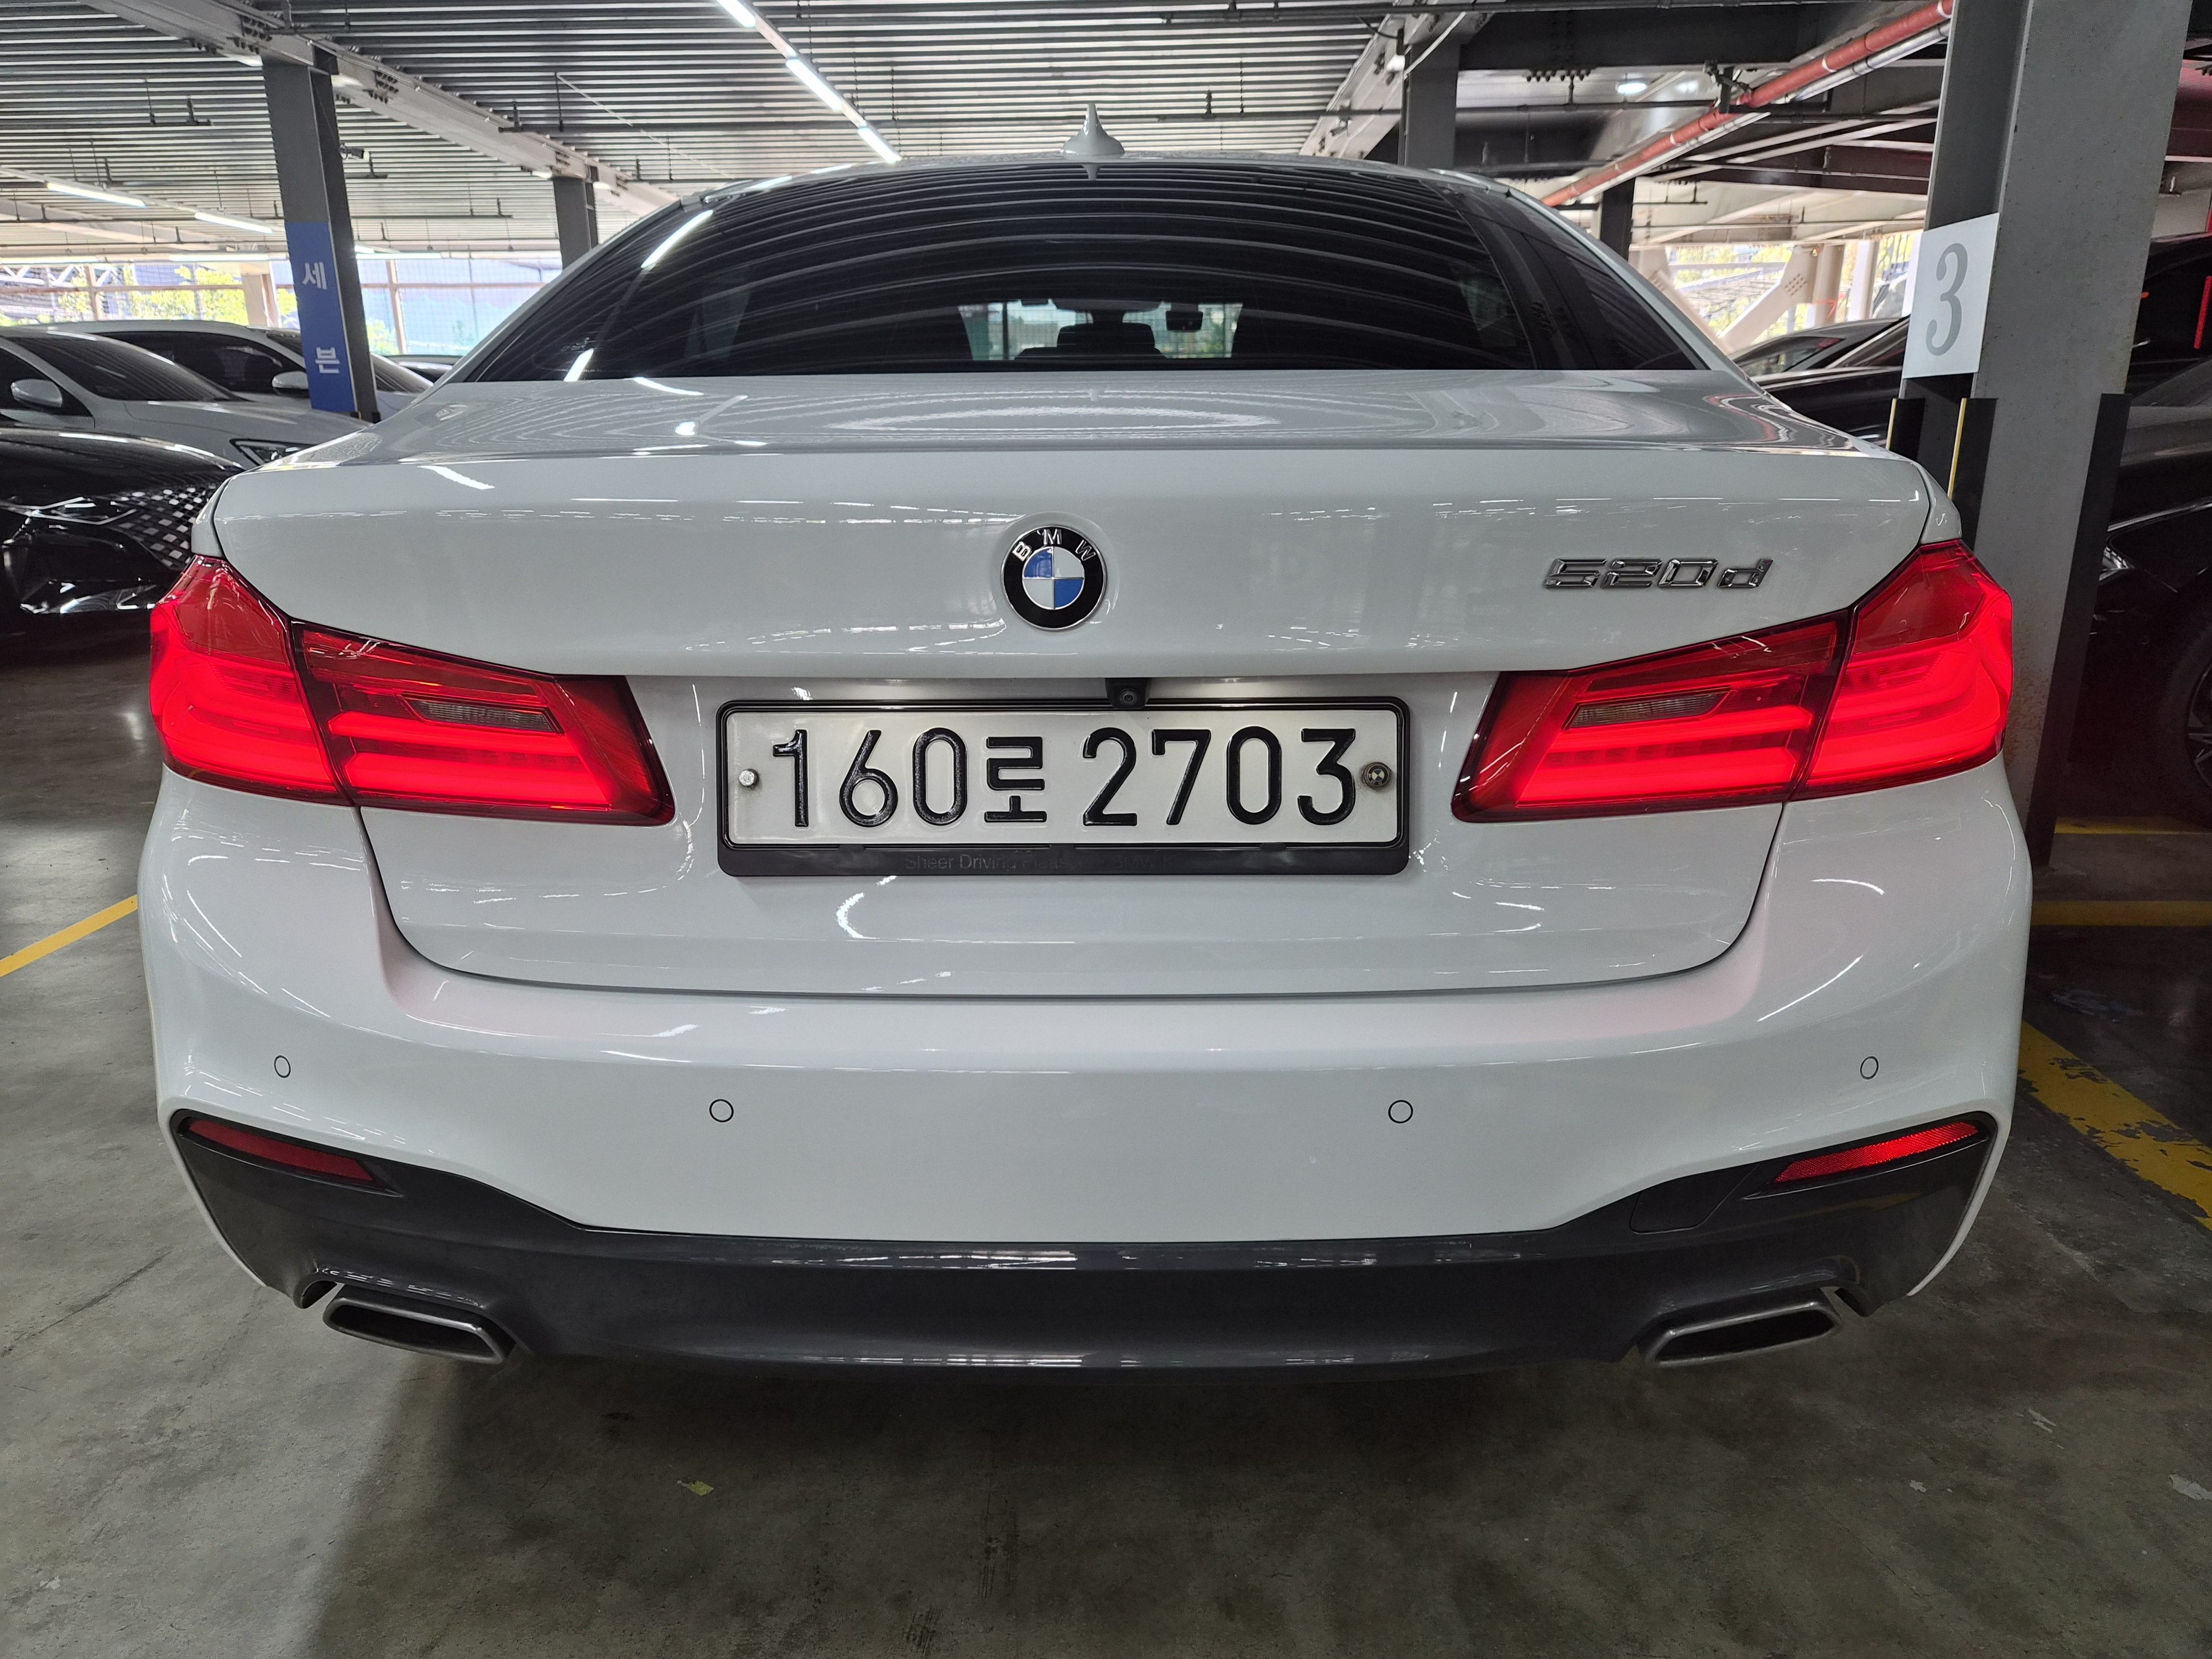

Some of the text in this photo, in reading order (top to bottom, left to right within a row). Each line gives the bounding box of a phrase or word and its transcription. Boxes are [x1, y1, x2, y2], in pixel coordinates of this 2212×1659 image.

[302, 261, 341, 374] 세븐
[1926, 243, 1968, 356] 3
[1012, 529, 1096, 562] BMW
[1543, 558, 1773, 589] 520d
[773, 726, 1357, 827] 160로 2703
[905, 854, 954, 869] Sheer
[959, 854, 1016, 872] Driving
